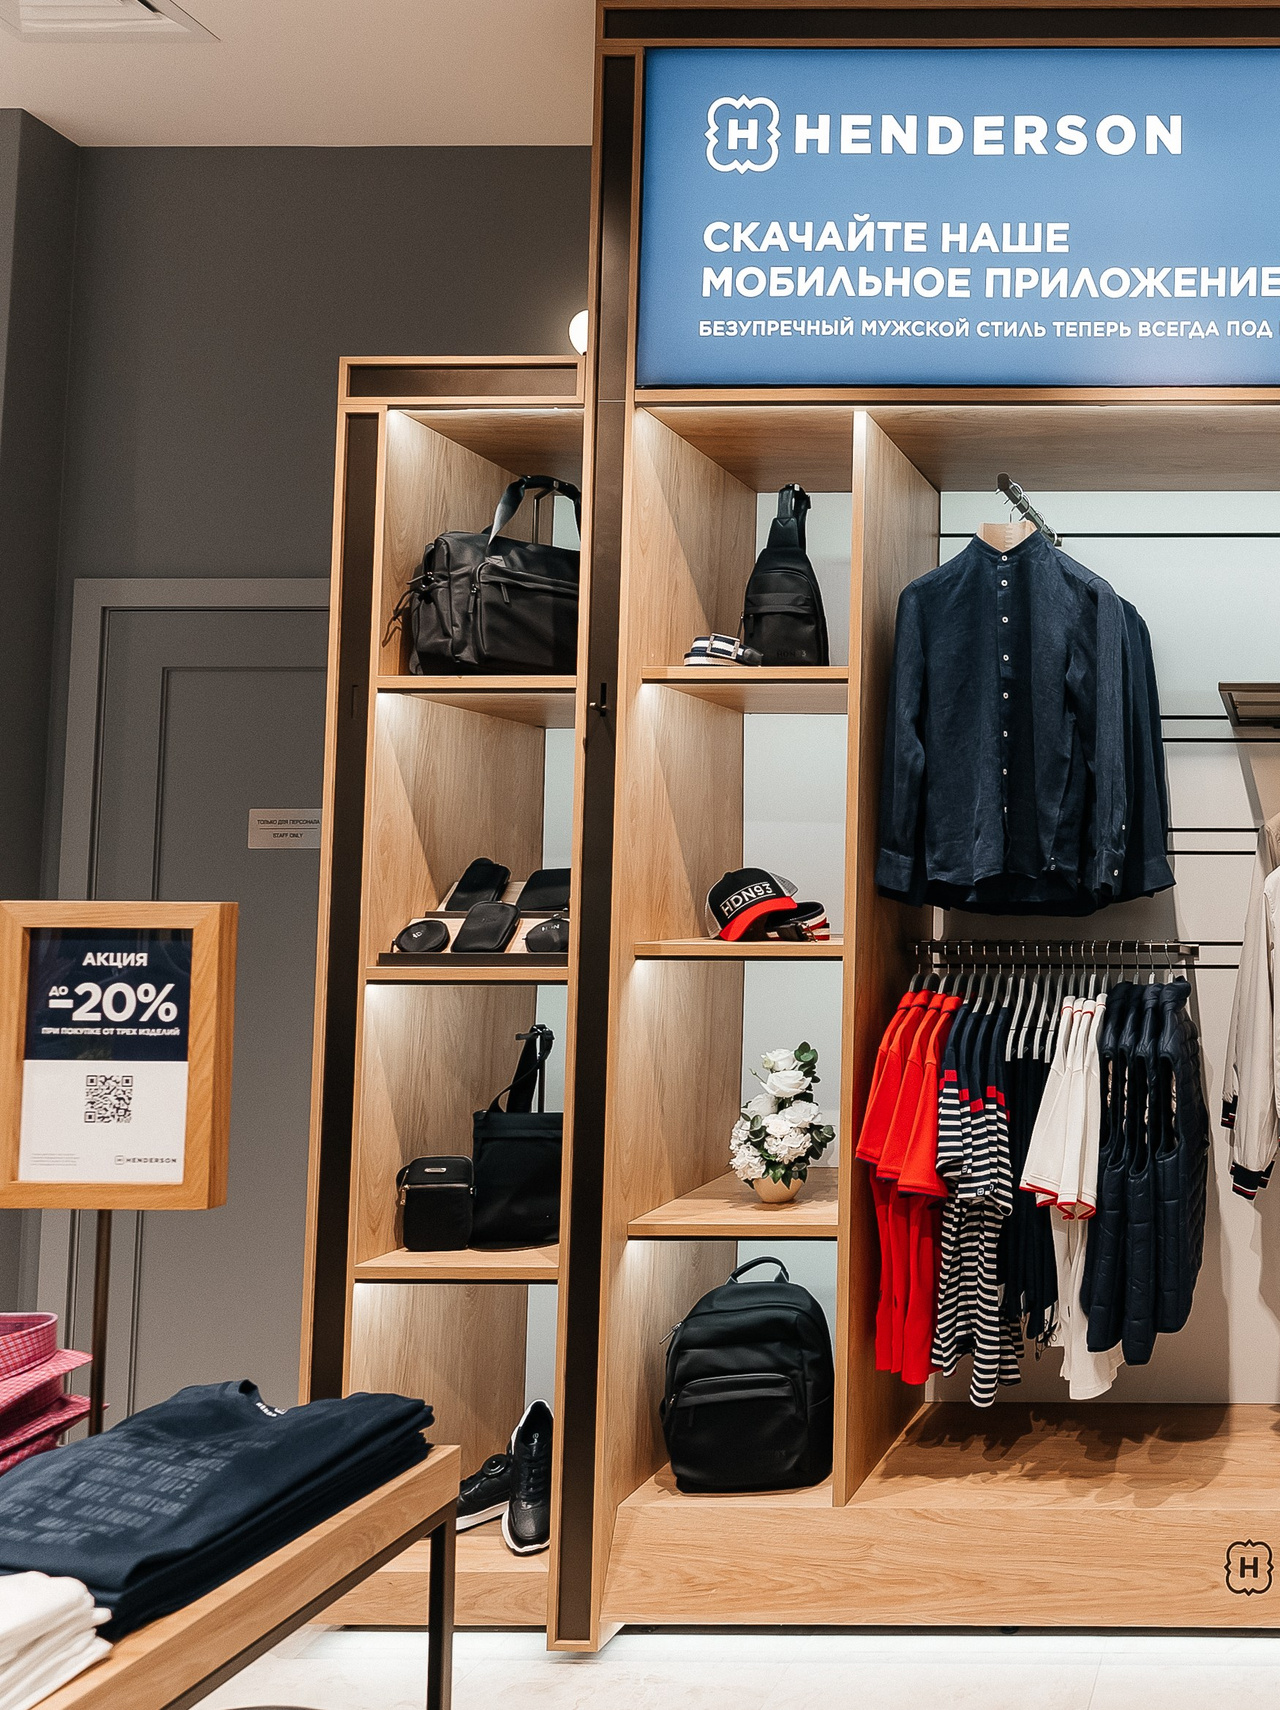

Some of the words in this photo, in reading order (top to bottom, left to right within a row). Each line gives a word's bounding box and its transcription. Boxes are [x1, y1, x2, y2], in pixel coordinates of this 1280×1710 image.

[795, 113, 1183, 156] HENDERSON
[703, 213, 928, 253] СКАЧАЙТЕ
[941, 221, 1070, 253] НАШЕ
[702, 265, 971, 299] МОБИЛЬНОЕ
[699, 316, 854, 337] БЕЗУПРЕЧНЫЙ
[861, 317, 970, 337] МУЖСКОЙ
[976, 320, 1047, 337] СТИЛЬ
[1052, 321, 1132, 337] ТЕПЕРЬ
[1138, 320, 1220, 339] ВСЕГДА
[1226, 320, 1273, 339] ПОД
[720, 882, 773, 917] HDN93
[82, 952, 148, 968] АКЦИЯ
[48, 985, 69, 997] ДО
[61, 1027, 101, 1035] ПОКУПКЕ
[138, 1027, 180, 1037] ИЗДЕЛИЙ
